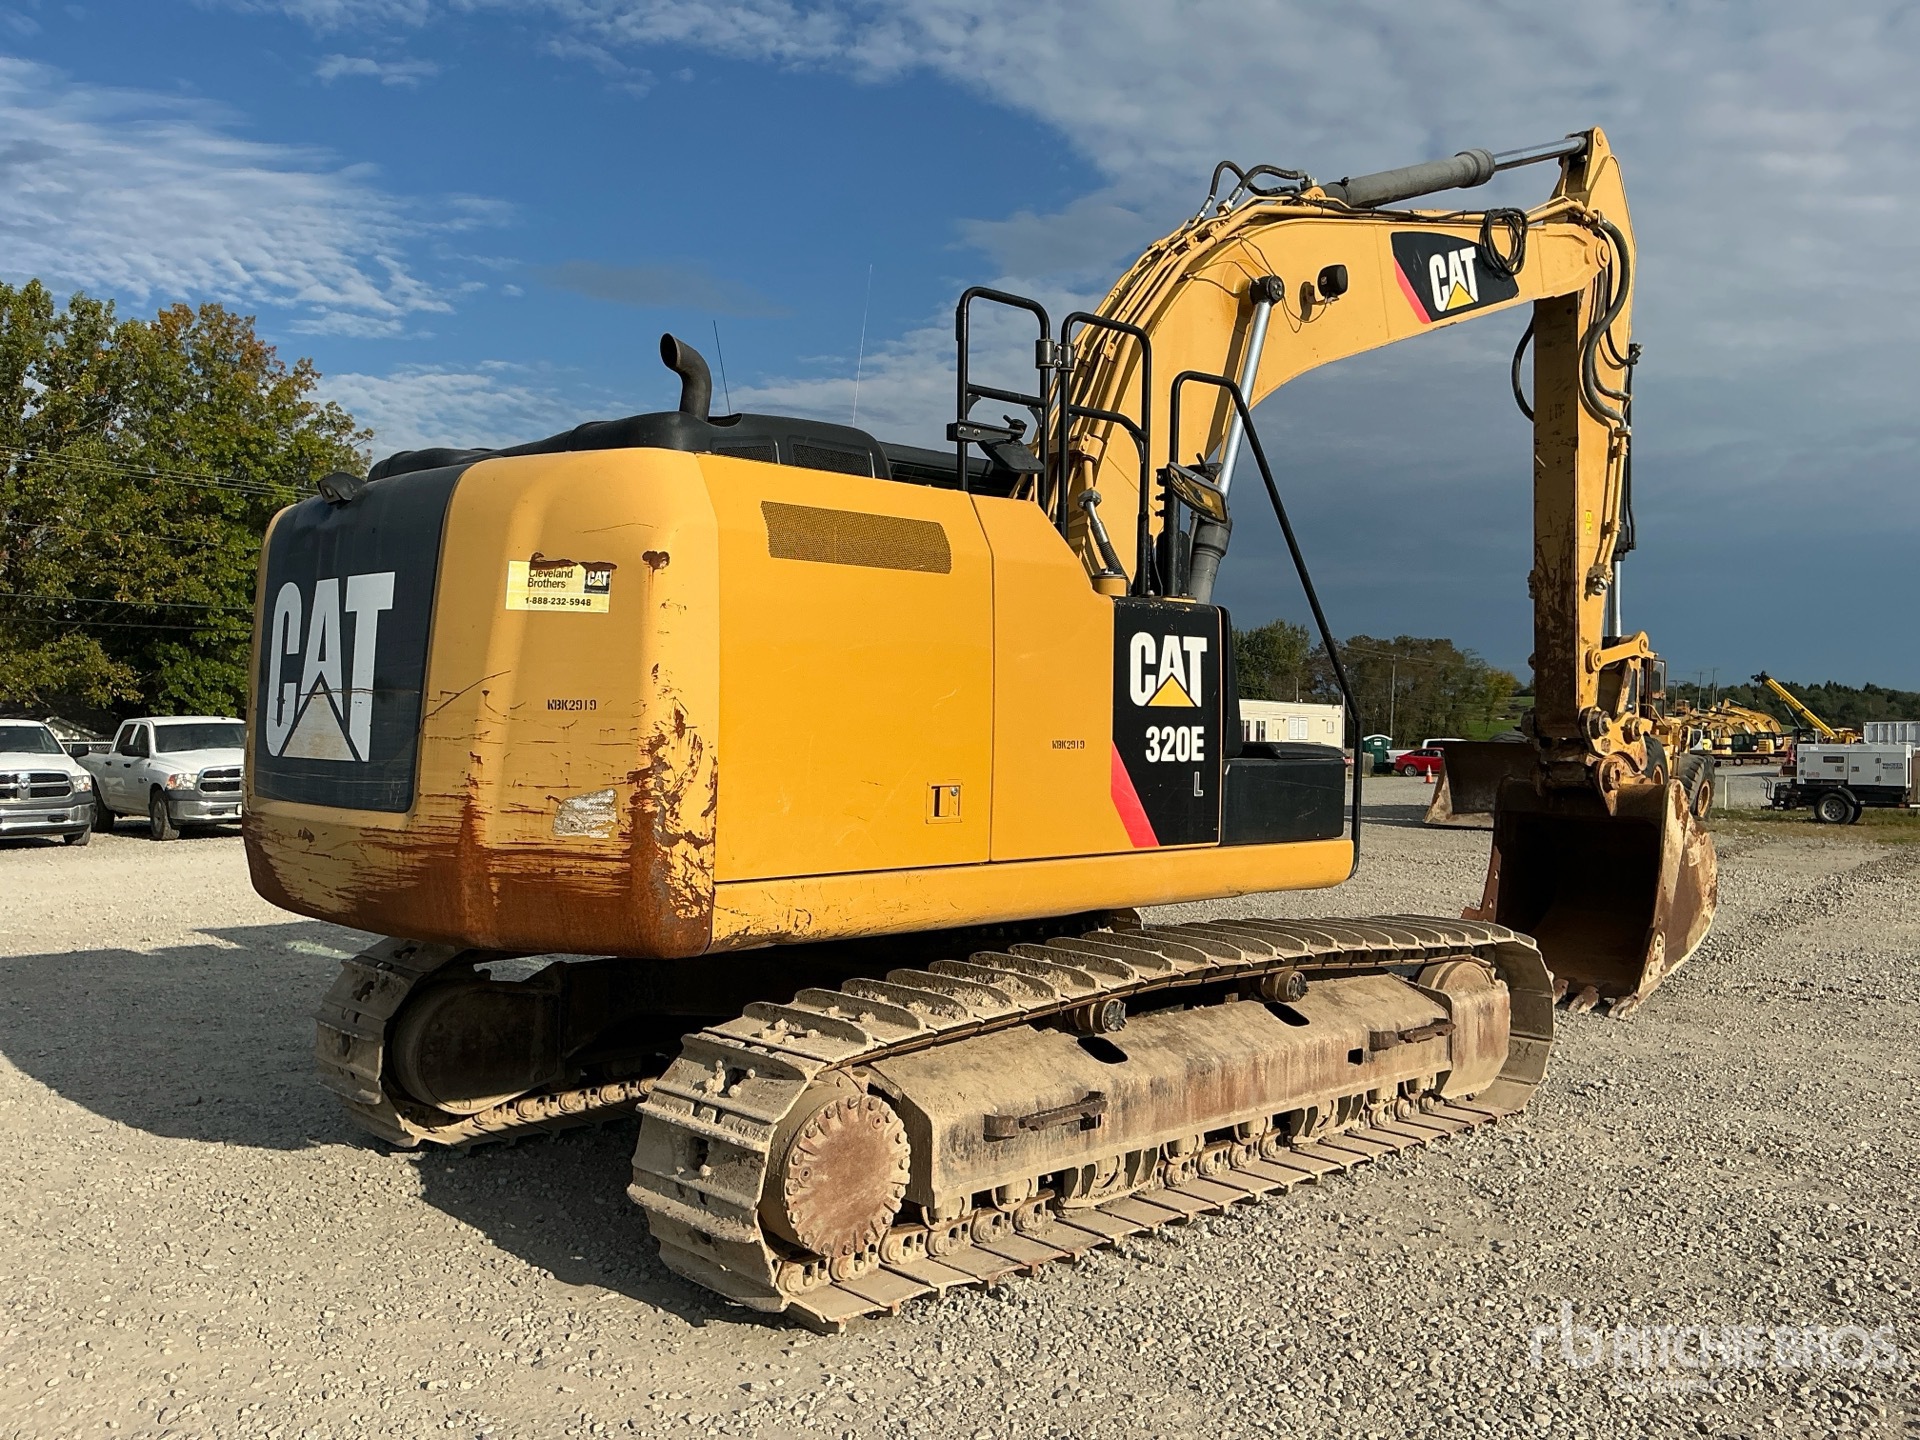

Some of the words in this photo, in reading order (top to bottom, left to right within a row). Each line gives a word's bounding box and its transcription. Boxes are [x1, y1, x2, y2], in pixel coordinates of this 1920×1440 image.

[1429, 247, 1478, 312] CAT
[527, 578, 566, 588] Brothers
[529, 568, 573, 578] Cleveland
[587, 571, 610, 587] CAT
[525, 596, 592, 606] 1-888-232-5948
[266, 571, 396, 763] CAT
[1130, 632, 1207, 707] CAT
[1145, 727, 1205, 762] 320E
[1194, 771, 1204, 797] L
